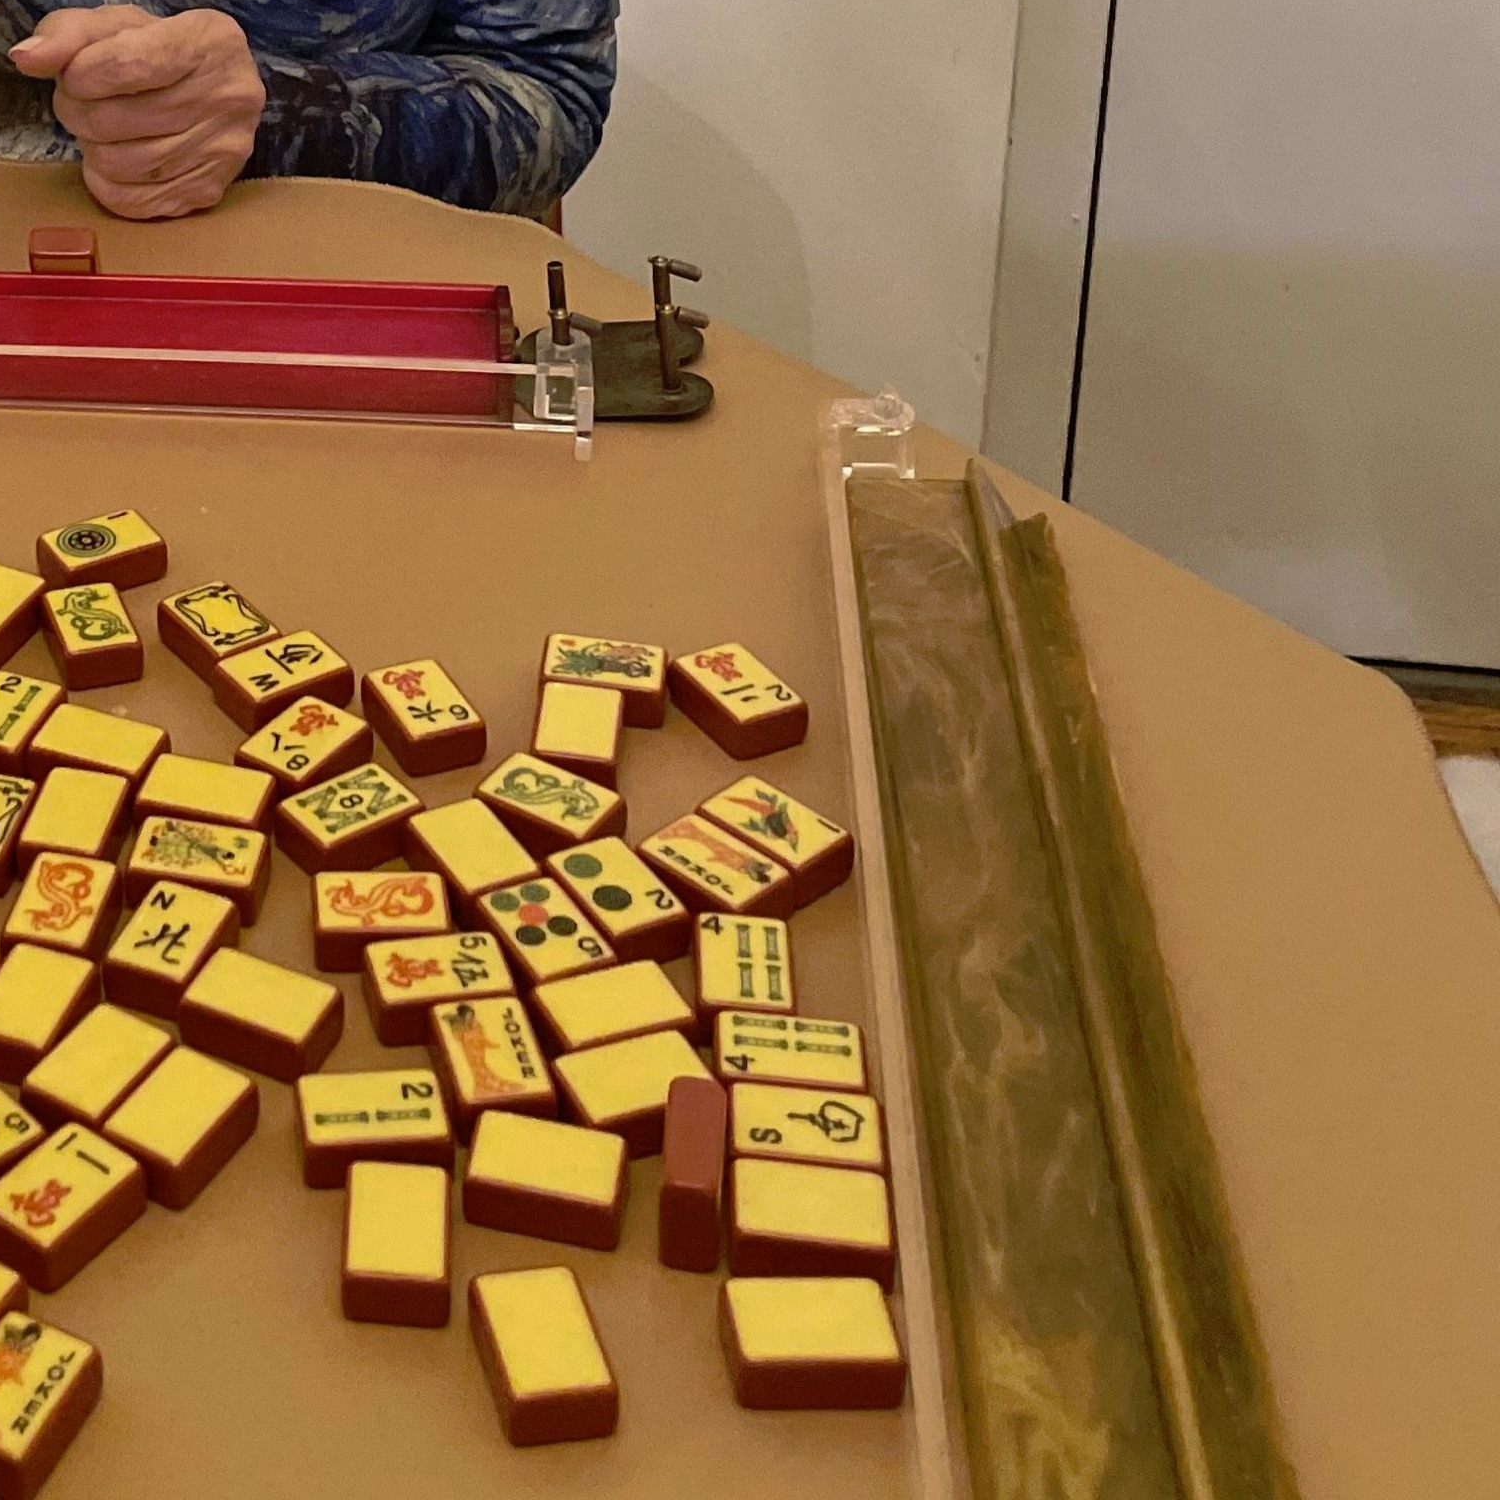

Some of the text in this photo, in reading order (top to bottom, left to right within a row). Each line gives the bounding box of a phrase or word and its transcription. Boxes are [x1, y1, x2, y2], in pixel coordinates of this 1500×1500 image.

[0, 676, 21, 694] 2
[286, 754, 309, 771] 8
[657, 844, 735, 896] JOKER
[150, 890, 176, 910] N
[701, 916, 723, 936] 4
[502, 1007, 537, 1079] JOKER
[10, 1351, 76, 1435] JOKER
